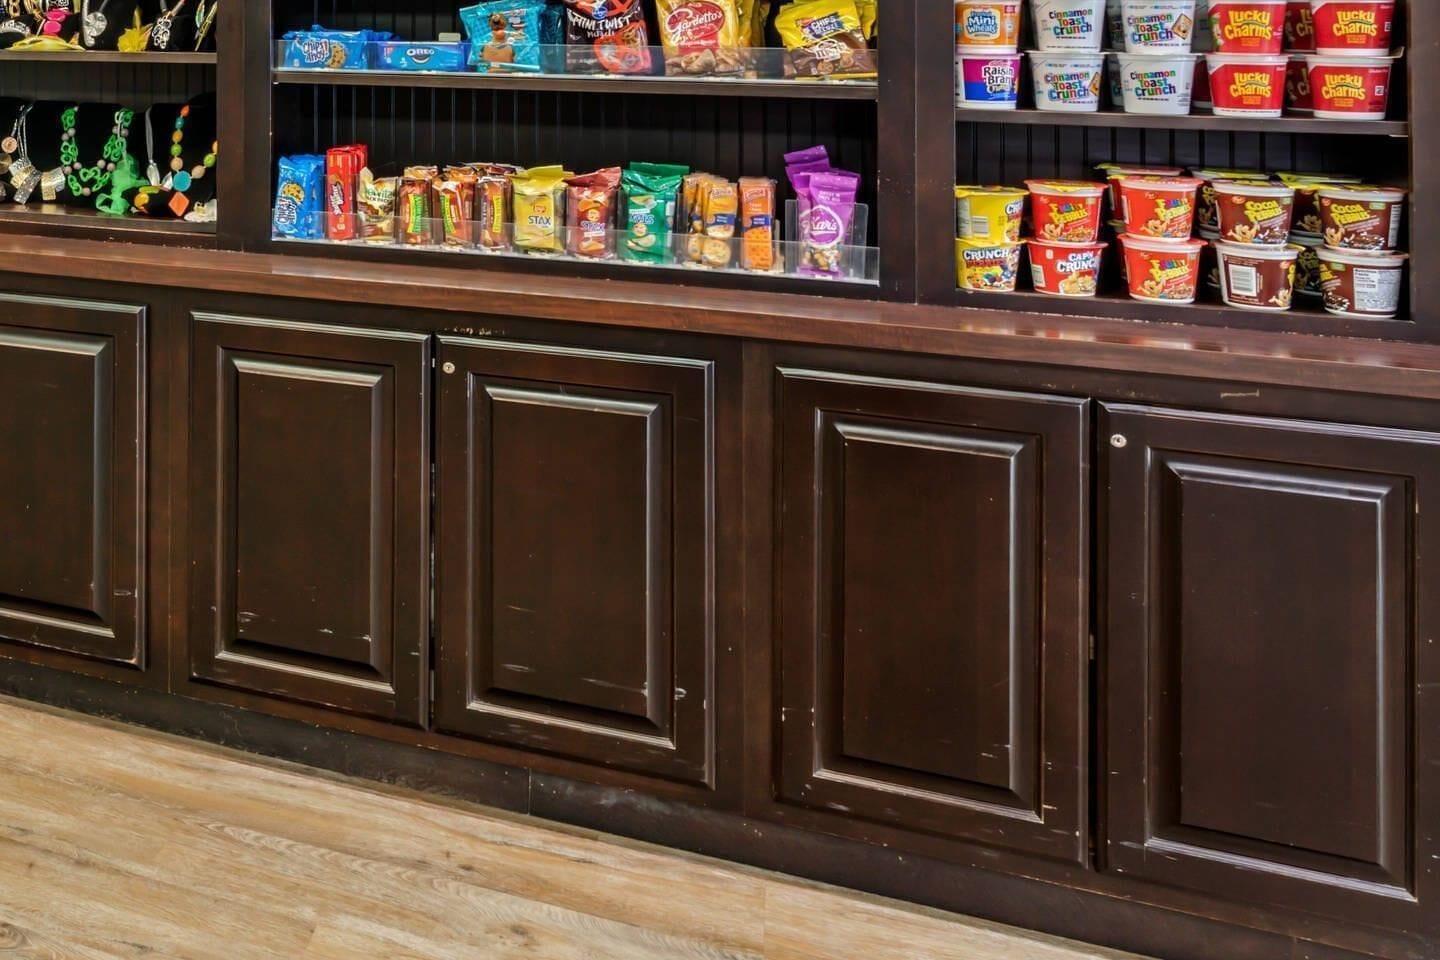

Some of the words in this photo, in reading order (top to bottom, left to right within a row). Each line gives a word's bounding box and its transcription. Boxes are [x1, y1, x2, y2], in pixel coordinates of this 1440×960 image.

[1049, 8, 1093, 19] Cinnamon
[1127, 13, 1173, 26] Cinnamon
[1229, 10, 1271, 26] Lucky
[1337, 10, 1375, 25] Lucky
[599, 16, 632, 29] TWIST
[666, 8, 722, 35] Gardetto's
[968, 16, 994, 25] Mini
[1057, 16, 1086, 27] Toast
[1053, 23, 1092, 36] Crunch
[1134, 22, 1164, 33] Toast
[1224, 22, 1272, 40] Charms
[1333, 22, 1377, 37] Charms
[1132, 28, 1173, 43] Crunch
[983, 67, 1013, 76] Raisin
[1044, 72, 1090, 83] Cinnamon
[1130, 70, 1176, 80] Cinnamon
[1052, 80, 1082, 90] Toast
[1137, 78, 1168, 88] Toast
[1234, 72, 1270, 87] Lucky
[1324, 74, 1363, 88] Lucky
[1048, 87, 1089, 101] Crunch
[1135, 84, 1176, 97] Crunch
[1229, 83, 1271, 98] Charms
[1322, 85, 1365, 100] Charms
[1245, 201, 1279, 210] COCOA
[1330, 203, 1364, 214] COCOA
[528, 215, 552, 226] STAX
[963, 250, 1010, 261] CRUNCH
[1056, 260, 1096, 273] CRUNC
